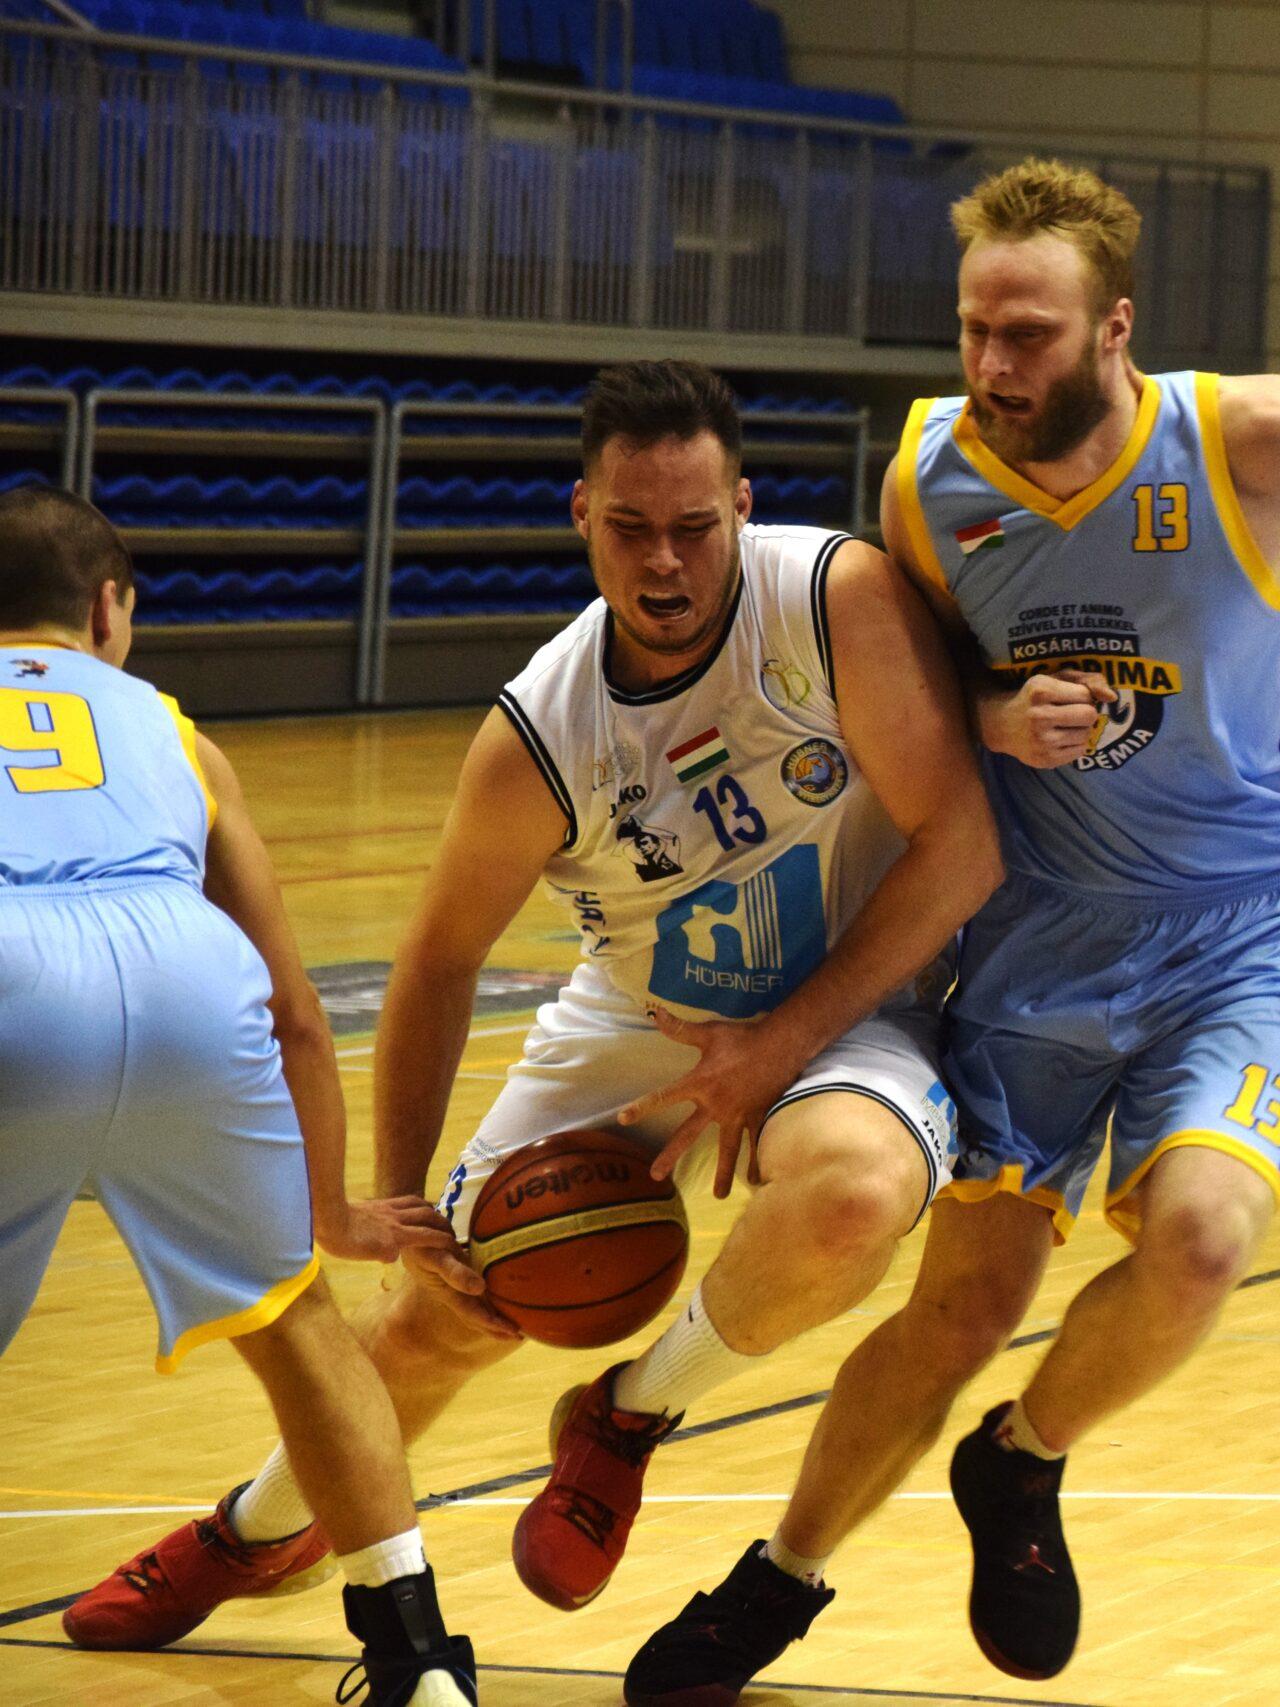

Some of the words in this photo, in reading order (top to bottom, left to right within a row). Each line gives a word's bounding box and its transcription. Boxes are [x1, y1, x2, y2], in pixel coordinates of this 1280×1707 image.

[1132, 482, 1190, 552] 13
[1018, 605, 1060, 622] CORDE
[1062, 604, 1077, 616] ET
[1079, 604, 1124, 617] ANIMO
[1060, 617, 1074, 629] ÉS
[1077, 616, 1137, 632] LÉLEKKEL
[1013, 637, 1135, 660] KOSÁRLABDA
[0, 686, 107, 794] 9
[1077, 728, 1154, 772] DÉMIA
[609, 784, 647, 819] JKO
[692, 774, 767, 851] 13
[504, 1161, 631, 1210] molten
